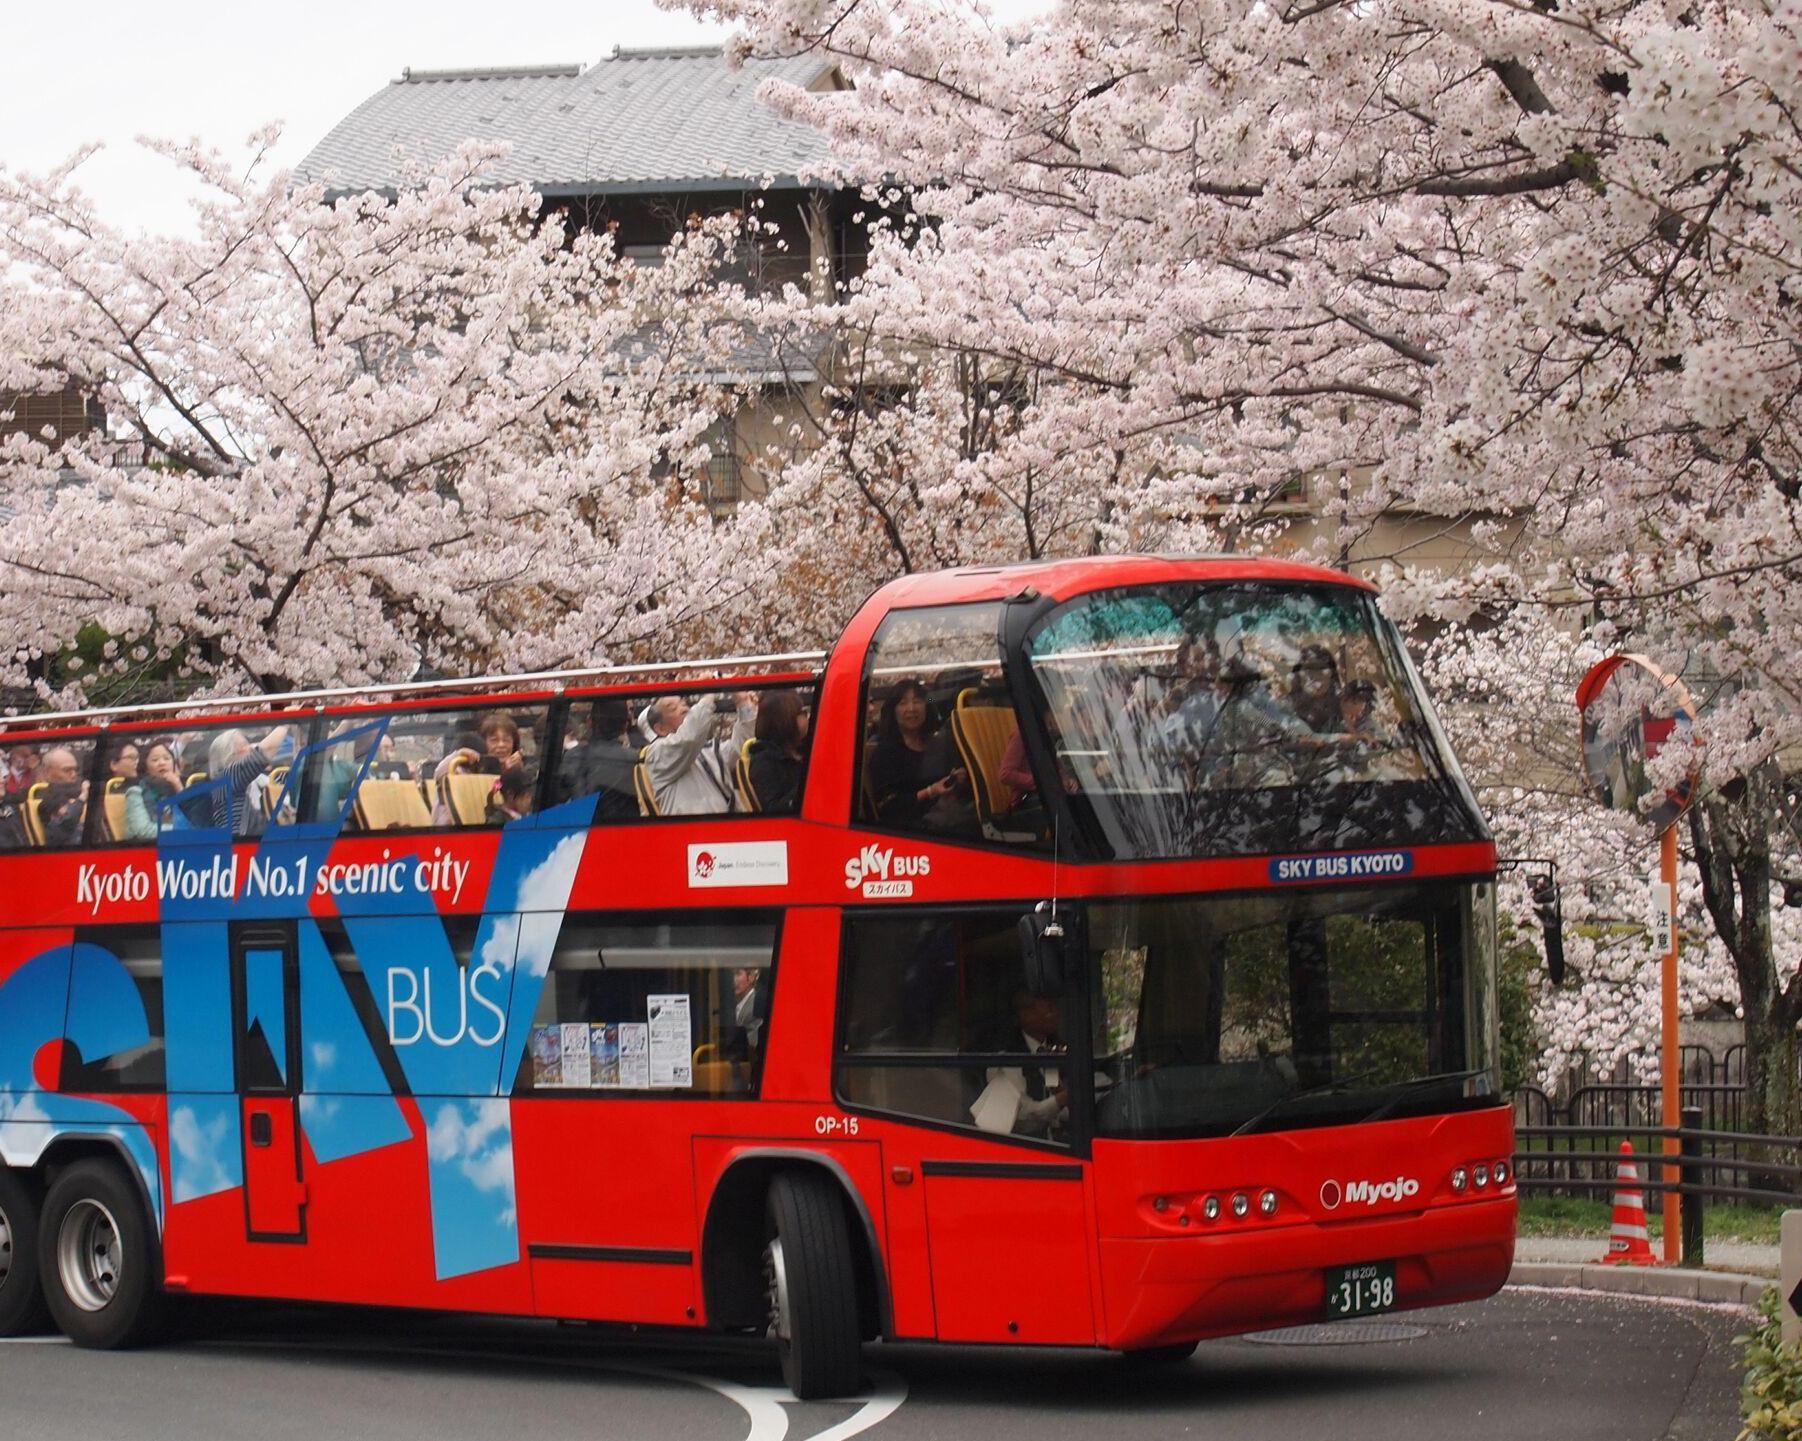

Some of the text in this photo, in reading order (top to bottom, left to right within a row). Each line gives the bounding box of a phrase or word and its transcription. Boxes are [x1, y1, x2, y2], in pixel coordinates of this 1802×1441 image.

[76, 846, 471, 916] Kyoto World No.1 scenic city
[844, 842, 931, 890] SKY BUS
[1278, 853, 1404, 879] SKY BUS KYOTO
[1656, 910, 1669, 950] 注意
[387, 965, 506, 1047] BUS
[815, 1116, 859, 1135] OP-15
[1345, 1176, 1420, 1206] Myojo
